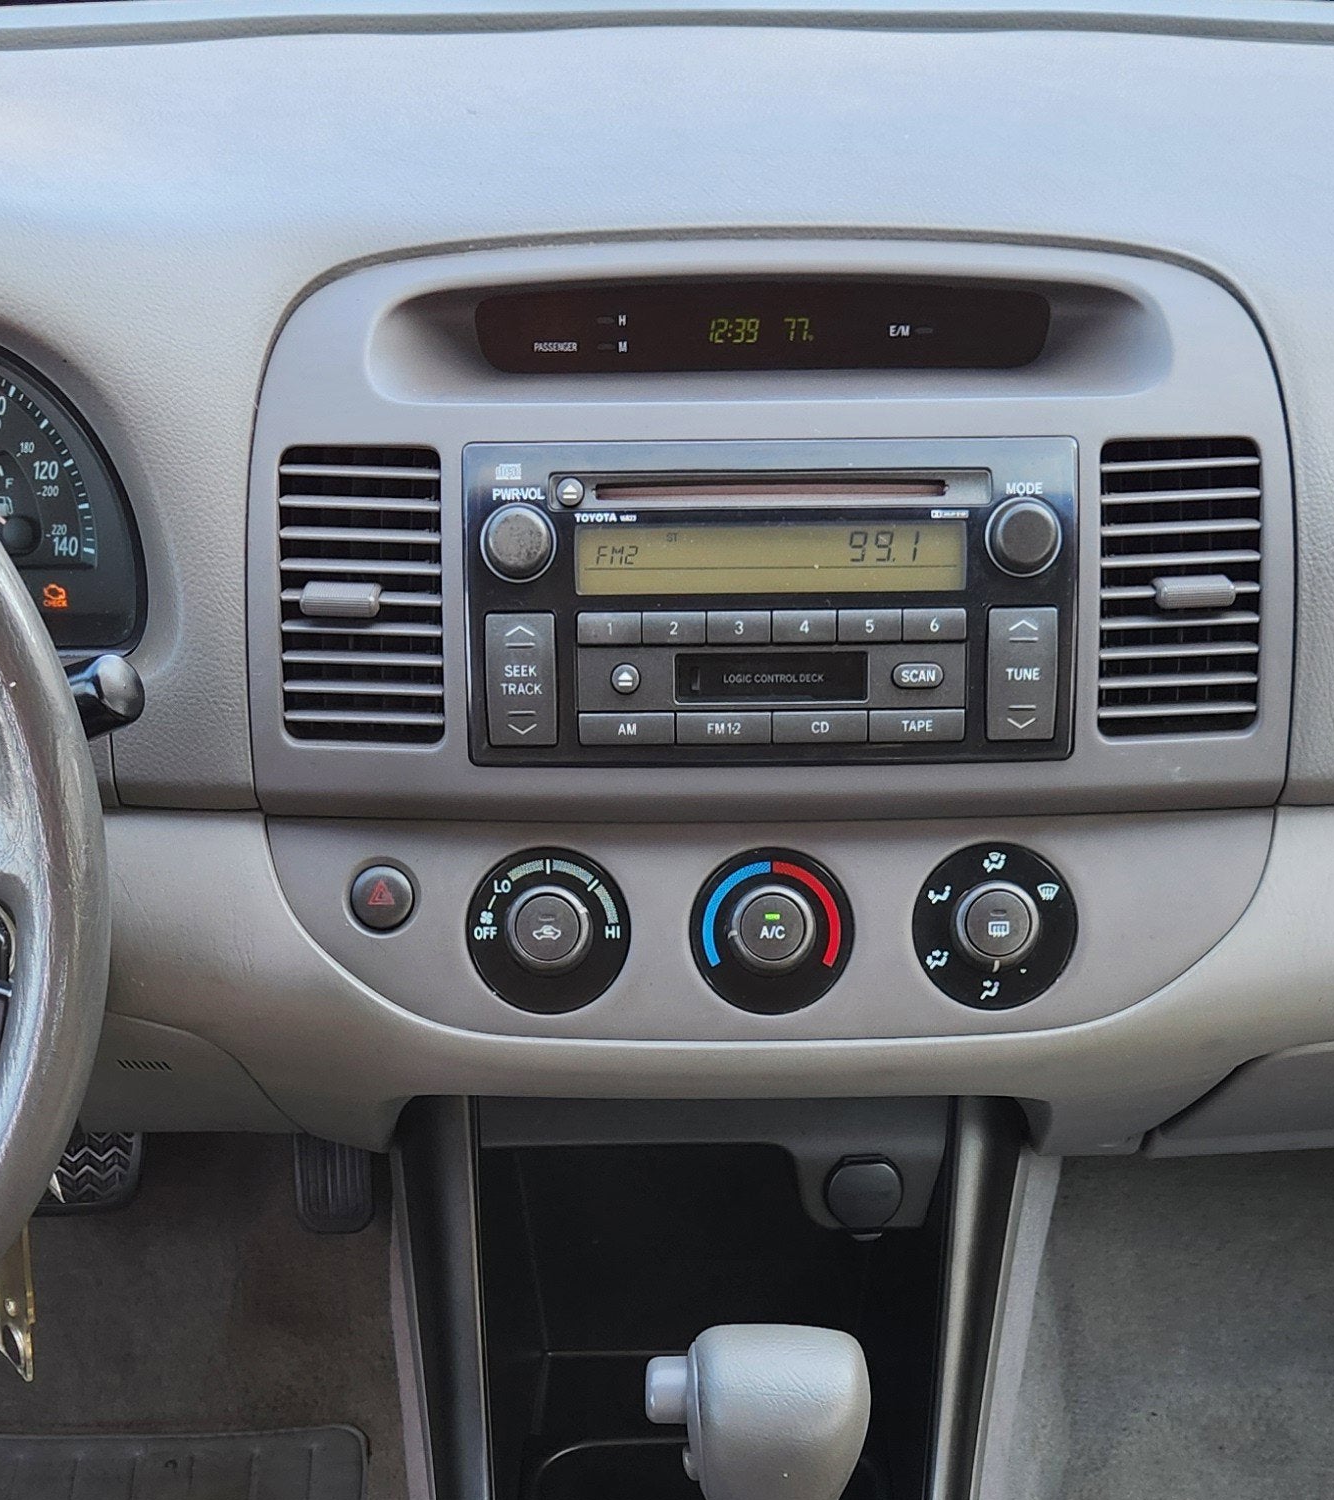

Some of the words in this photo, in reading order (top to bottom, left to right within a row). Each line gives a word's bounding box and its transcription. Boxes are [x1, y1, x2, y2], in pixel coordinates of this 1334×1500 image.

[618, 314, 627, 326] H
[708, 318, 760, 344] 12:39
[889, 324, 911, 338] E/M
[533, 341, 578, 353] PASSENGER
[618, 341, 628, 353] M
[19, 441, 35, 454] 180
[33, 460, 59, 480] 120
[5, 477, 15, 489] F
[1006, 482, 1043, 495] MODE
[42, 486, 60, 497] 200
[574, 512, 617, 523] TOYOTA
[51, 524, 67, 536] 220
[667, 532, 678, 543] ST
[52, 536, 78, 557] 140
[849, 531, 920, 562] 99.1
[596, 545, 639, 565] FM2
[43, 600, 68, 608] CHECK
[607, 621, 613, 635] 1
[669, 621, 679, 636] 2
[734, 620, 744, 635] 3
[799, 620, 810, 633] 4
[865, 619, 875, 633] 5
[929, 618, 940, 632] 6
[504, 665, 537, 678] SEEK
[723, 672, 752, 684] LOGIC
[754, 672, 798, 684] CONTROL
[799, 672, 825, 683] DECK
[900, 669, 936, 683] SCAN
[1005, 667, 1041, 681] TUNE
[500, 683, 543, 695] TRACK
[618, 723, 637, 735] AM
[707, 723, 725, 735] FM
[811, 721, 829, 734] CD
[901, 720, 933, 732] TAPE
[493, 879, 512, 893] LO
[473, 926, 498, 940] OFF
[605, 925, 621, 939] HI
[759, 924, 786, 942] A/C
